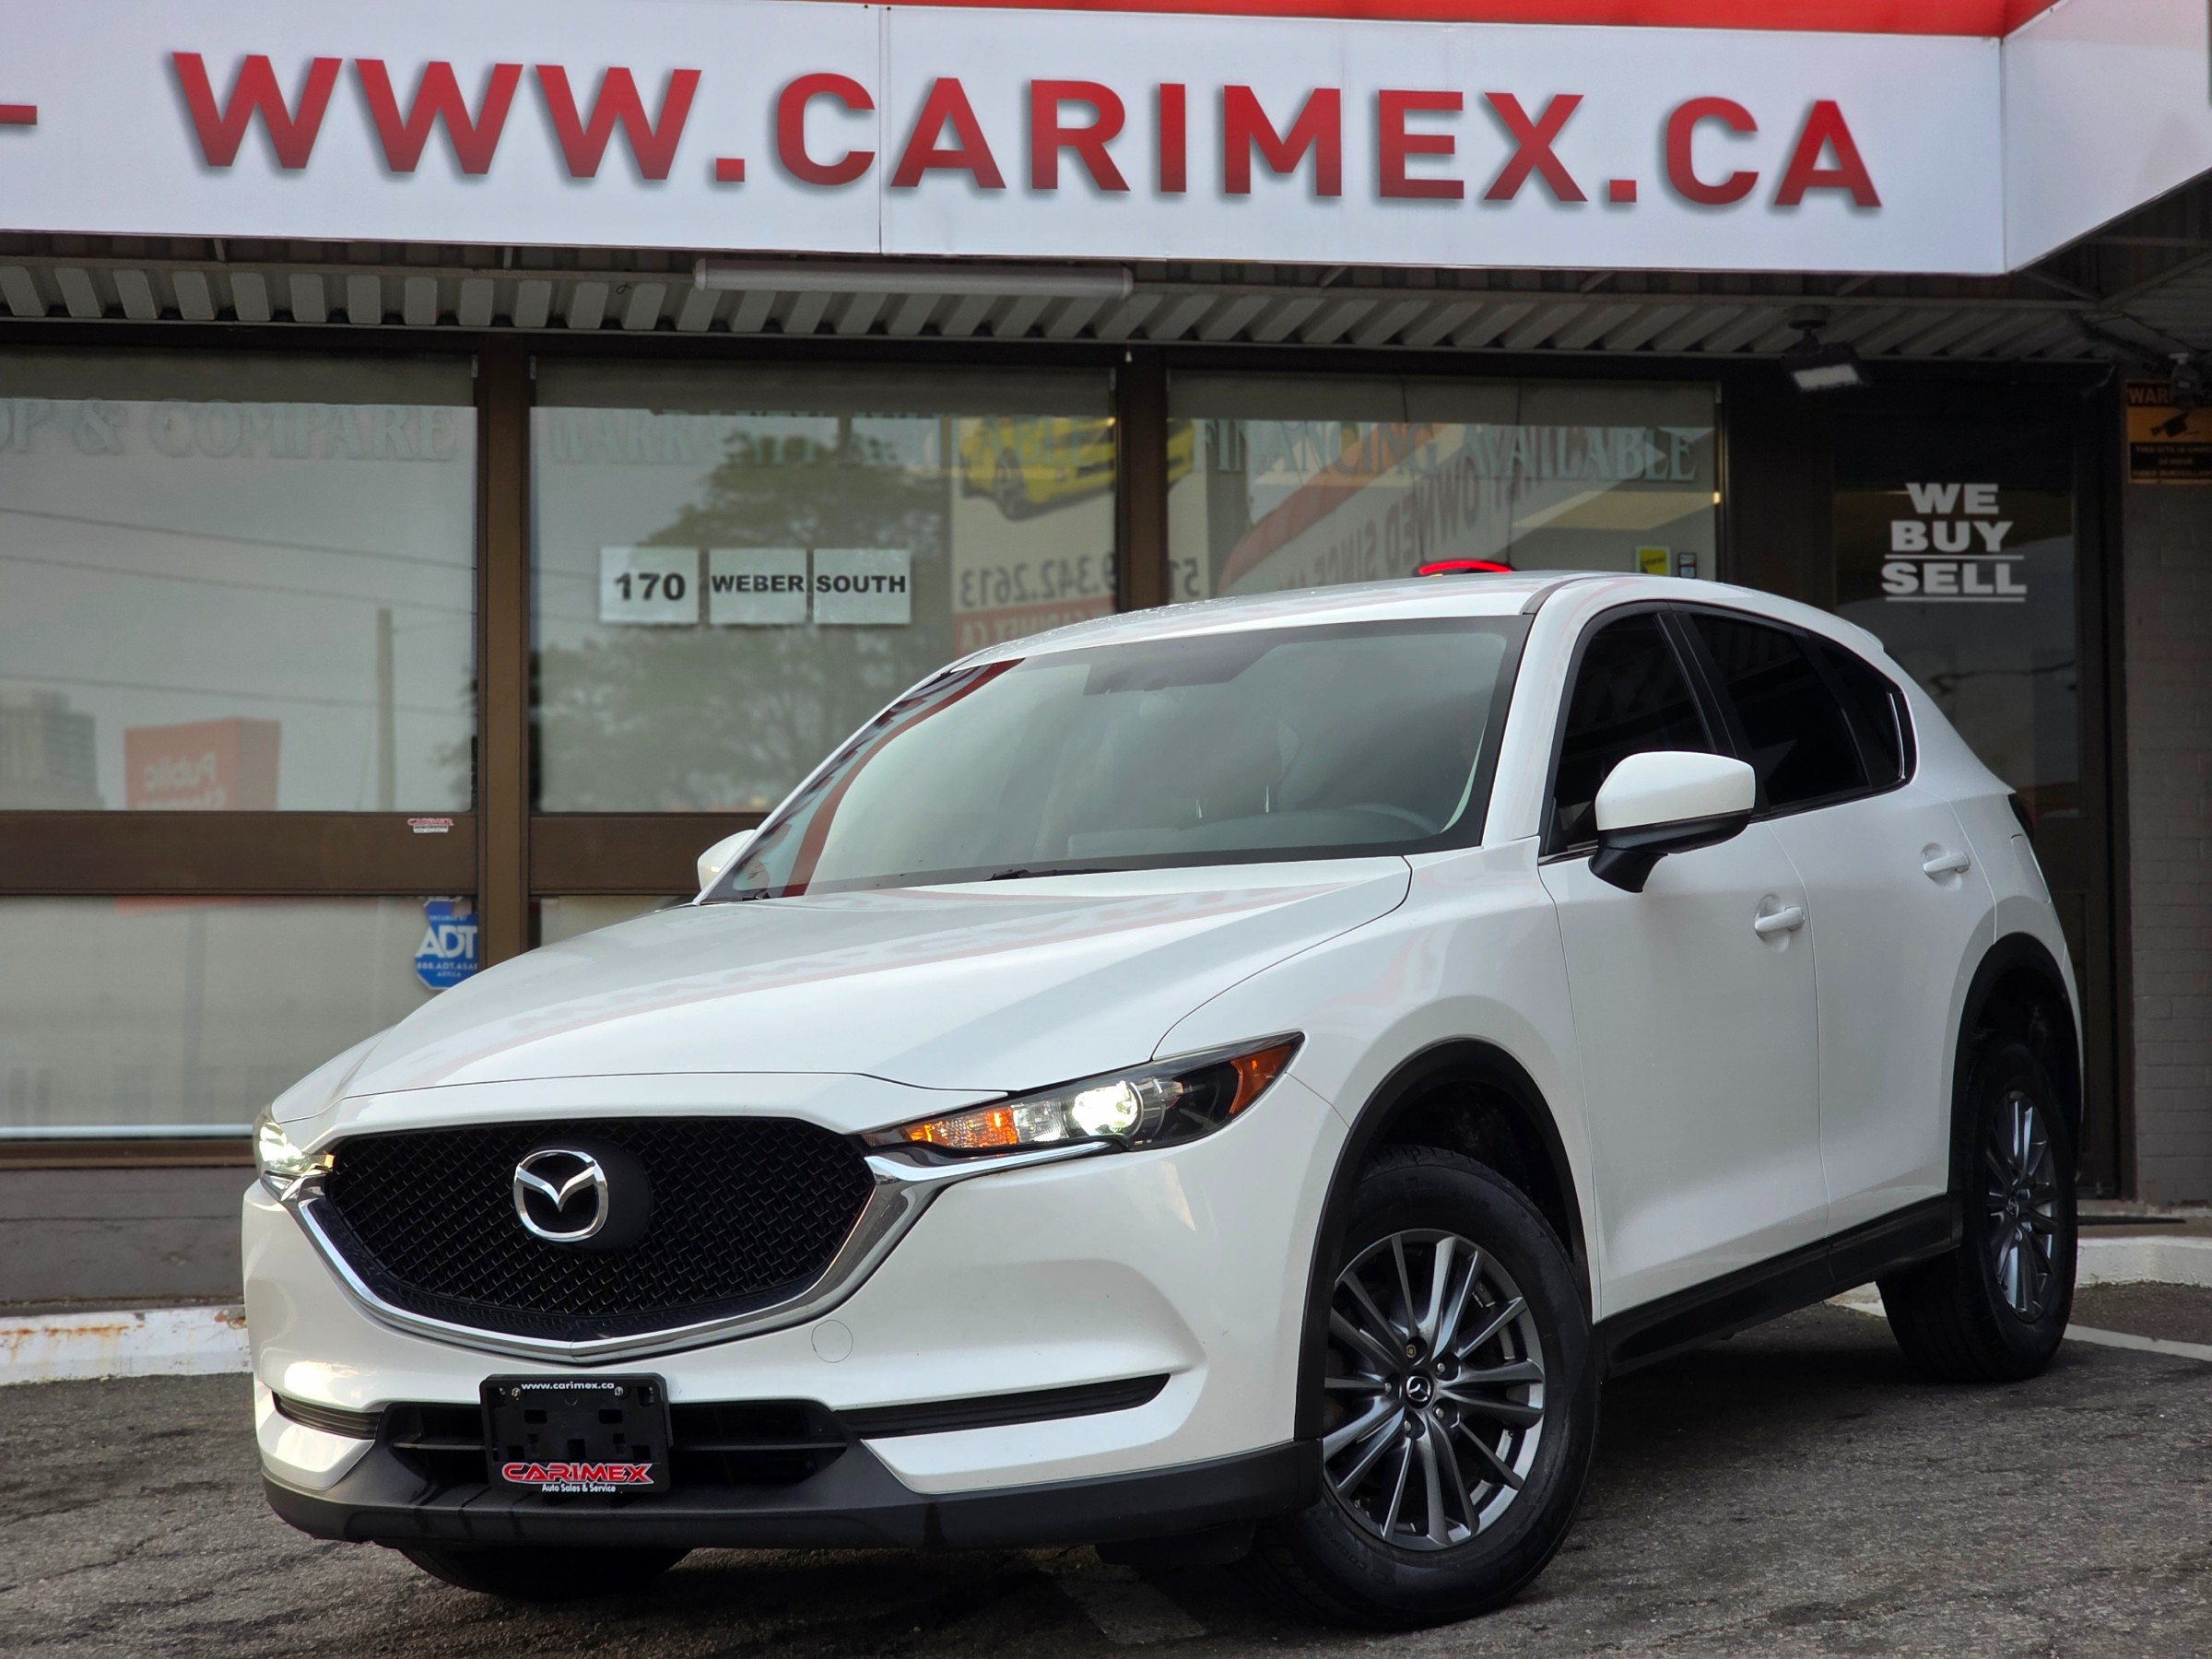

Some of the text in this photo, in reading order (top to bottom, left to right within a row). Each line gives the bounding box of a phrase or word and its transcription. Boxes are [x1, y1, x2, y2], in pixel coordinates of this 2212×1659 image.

[171, 52, 1883, 207] WWW.CARIMEX.CA
[151, 400, 459, 462] COMPARE
[1457, 422, 1698, 482] AVAILABLE
[1905, 483, 1999, 514] WE
[1890, 521, 2013, 552] BUY
[614, 572, 906, 600] 170 WEBER SOUTH
[1881, 562, 2027, 594] SELL
[414, 924, 478, 959] ADT
[521, 1381, 615, 1390] www.carimex.ca
[502, 1462, 654, 1485] CARIMEX
[542, 1484, 617, 1493] Auto Sales & Service
